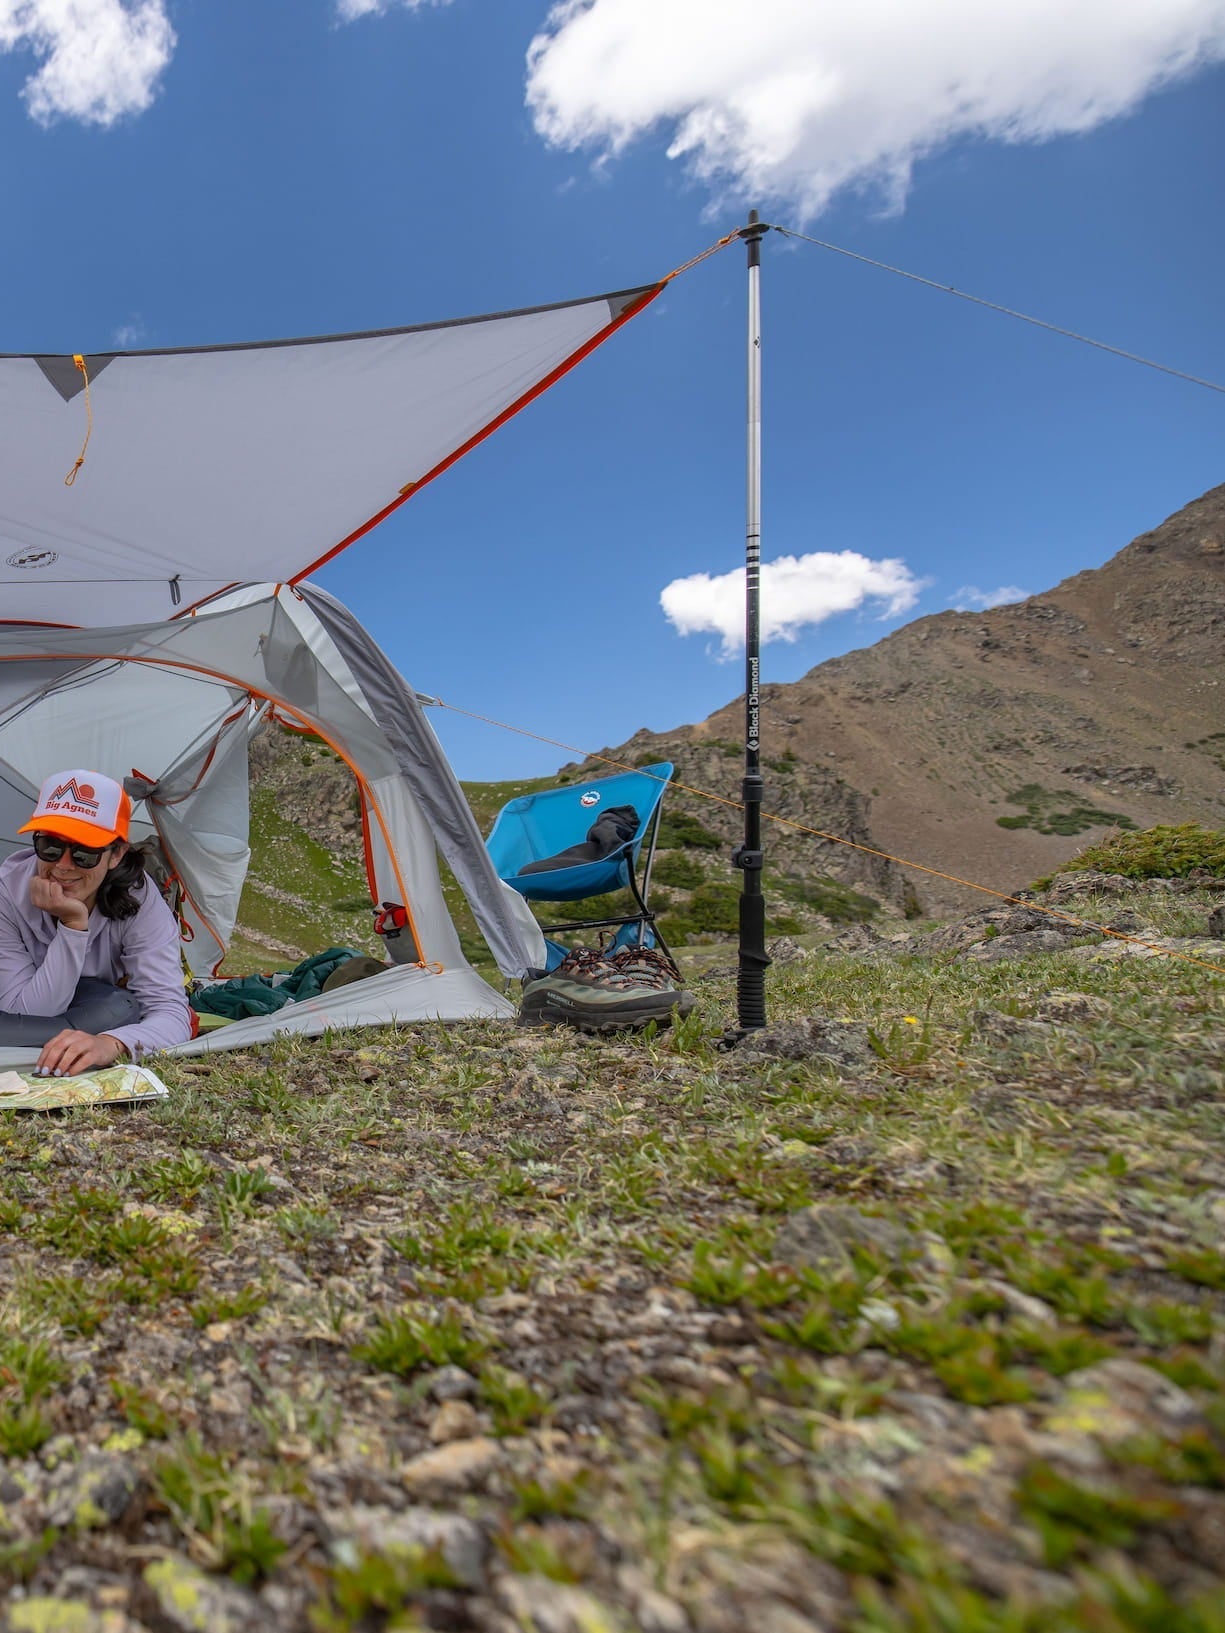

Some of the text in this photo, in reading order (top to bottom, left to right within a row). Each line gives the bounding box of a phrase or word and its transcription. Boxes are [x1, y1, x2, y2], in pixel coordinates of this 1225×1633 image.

[749, 656, 759, 737] Black Diamond
[45, 801, 97, 817] Big Agnes
